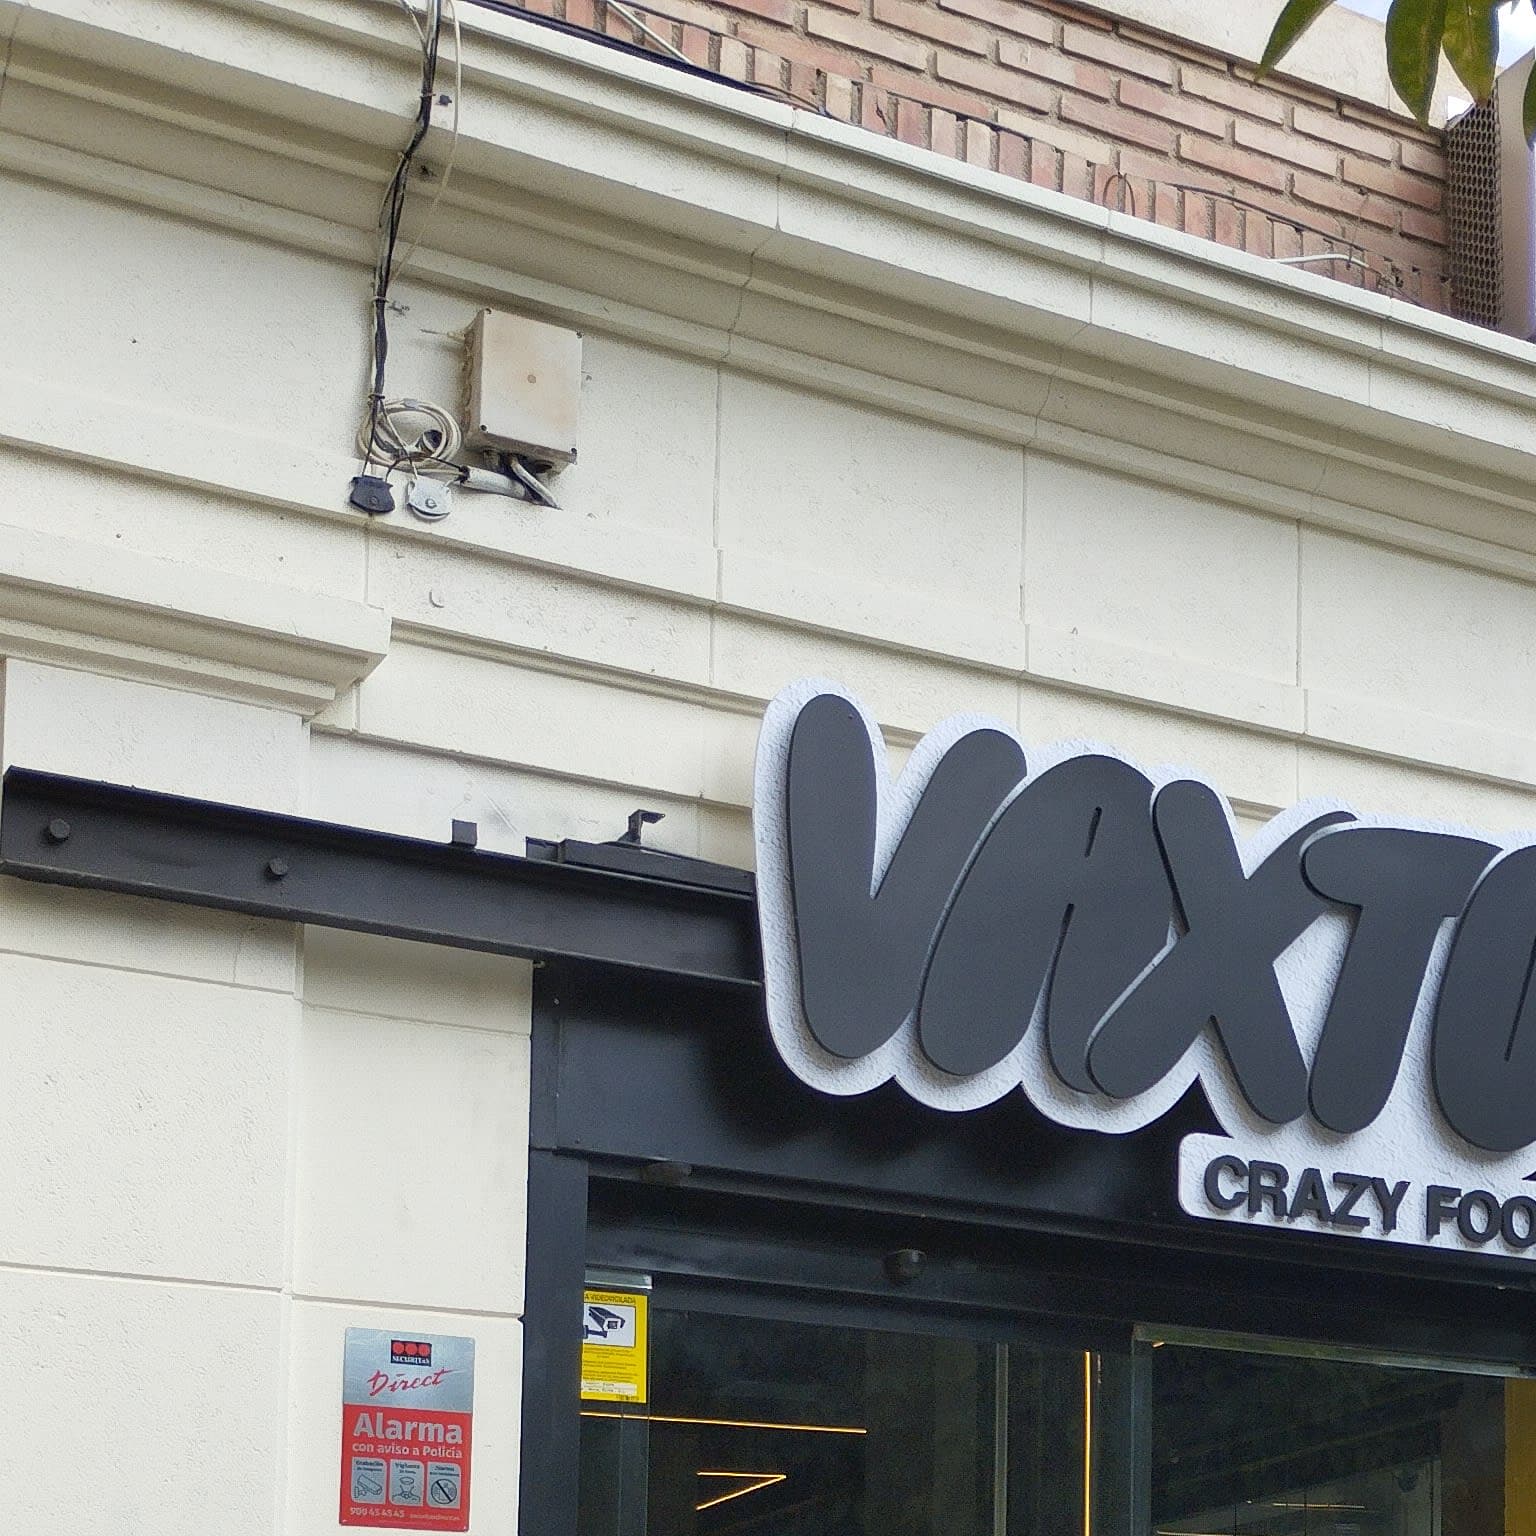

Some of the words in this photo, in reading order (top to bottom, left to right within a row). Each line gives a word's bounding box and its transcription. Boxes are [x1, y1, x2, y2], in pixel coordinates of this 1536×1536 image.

[1203, 1154, 1411, 1234] CRAZY
[367, 1367, 454, 1396] Direct
[353, 1412, 463, 1444] Alarma
[352, 1443, 374, 1453] con
[377, 1442, 410, 1455] aviso
[412, 1446, 420, 1456] a
[423, 1445, 462, 1459] Policía
